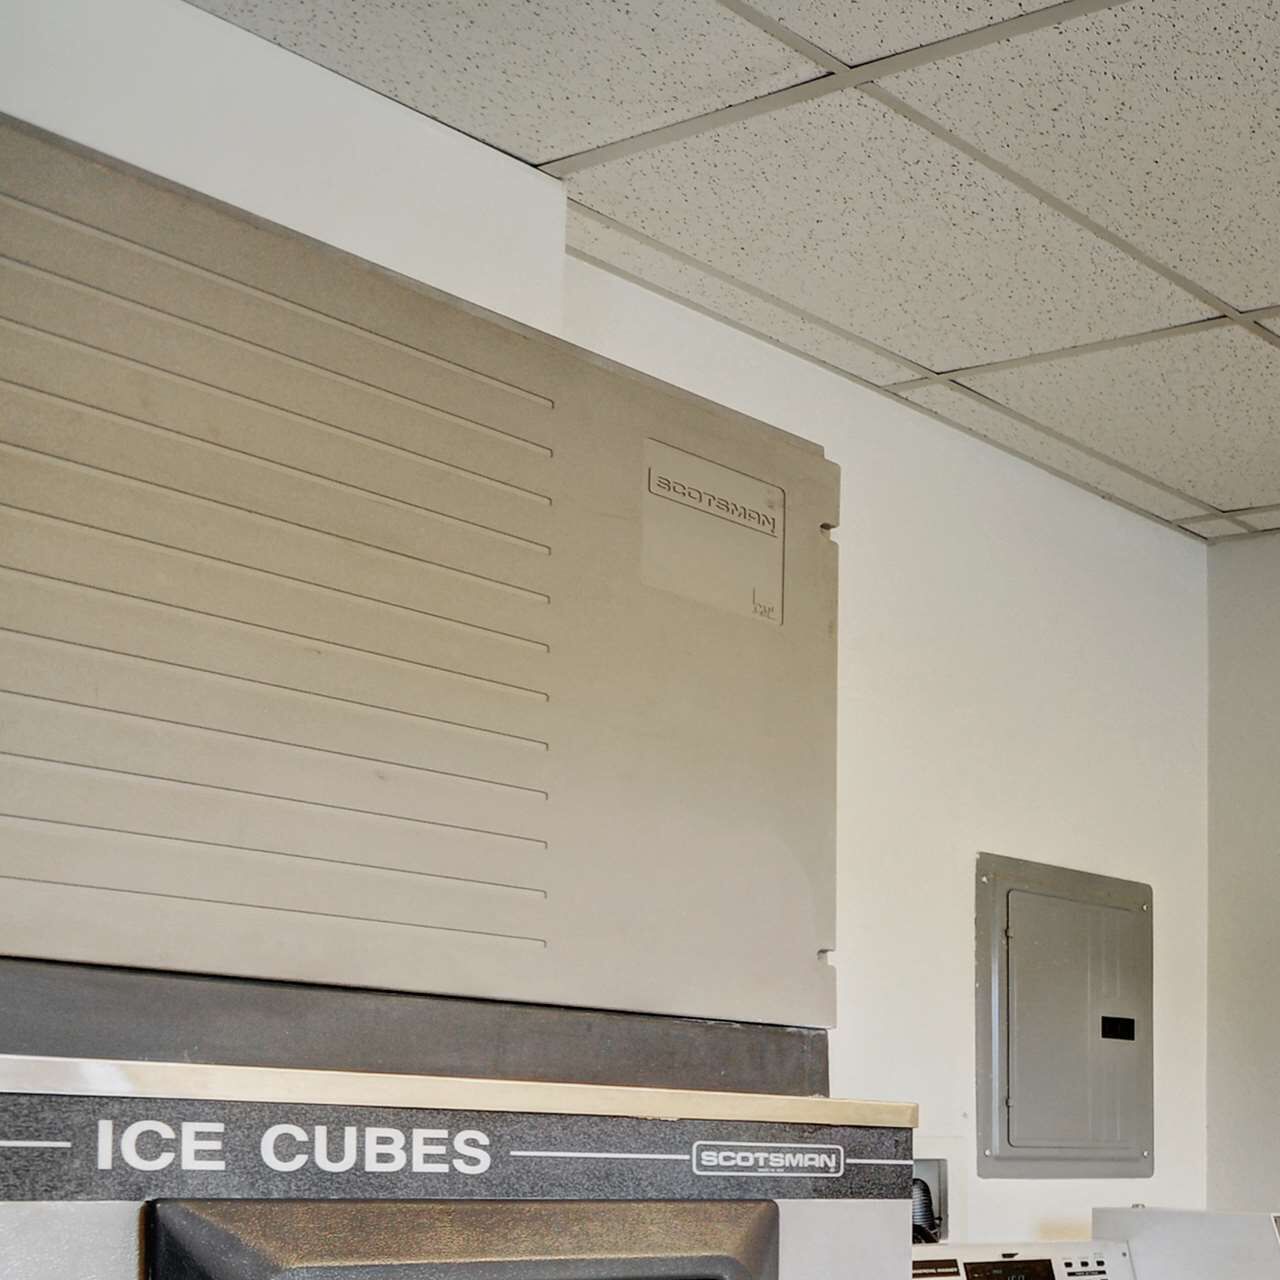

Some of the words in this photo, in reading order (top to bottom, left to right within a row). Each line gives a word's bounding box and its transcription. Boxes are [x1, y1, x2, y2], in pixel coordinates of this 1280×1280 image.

[656, 476, 776, 534] SCOTSMAN
[98, 1119, 226, 1171] ICE
[260, 1123, 491, 1175] CUBES
[700, 1151, 836, 1168] SCOTSMAN
